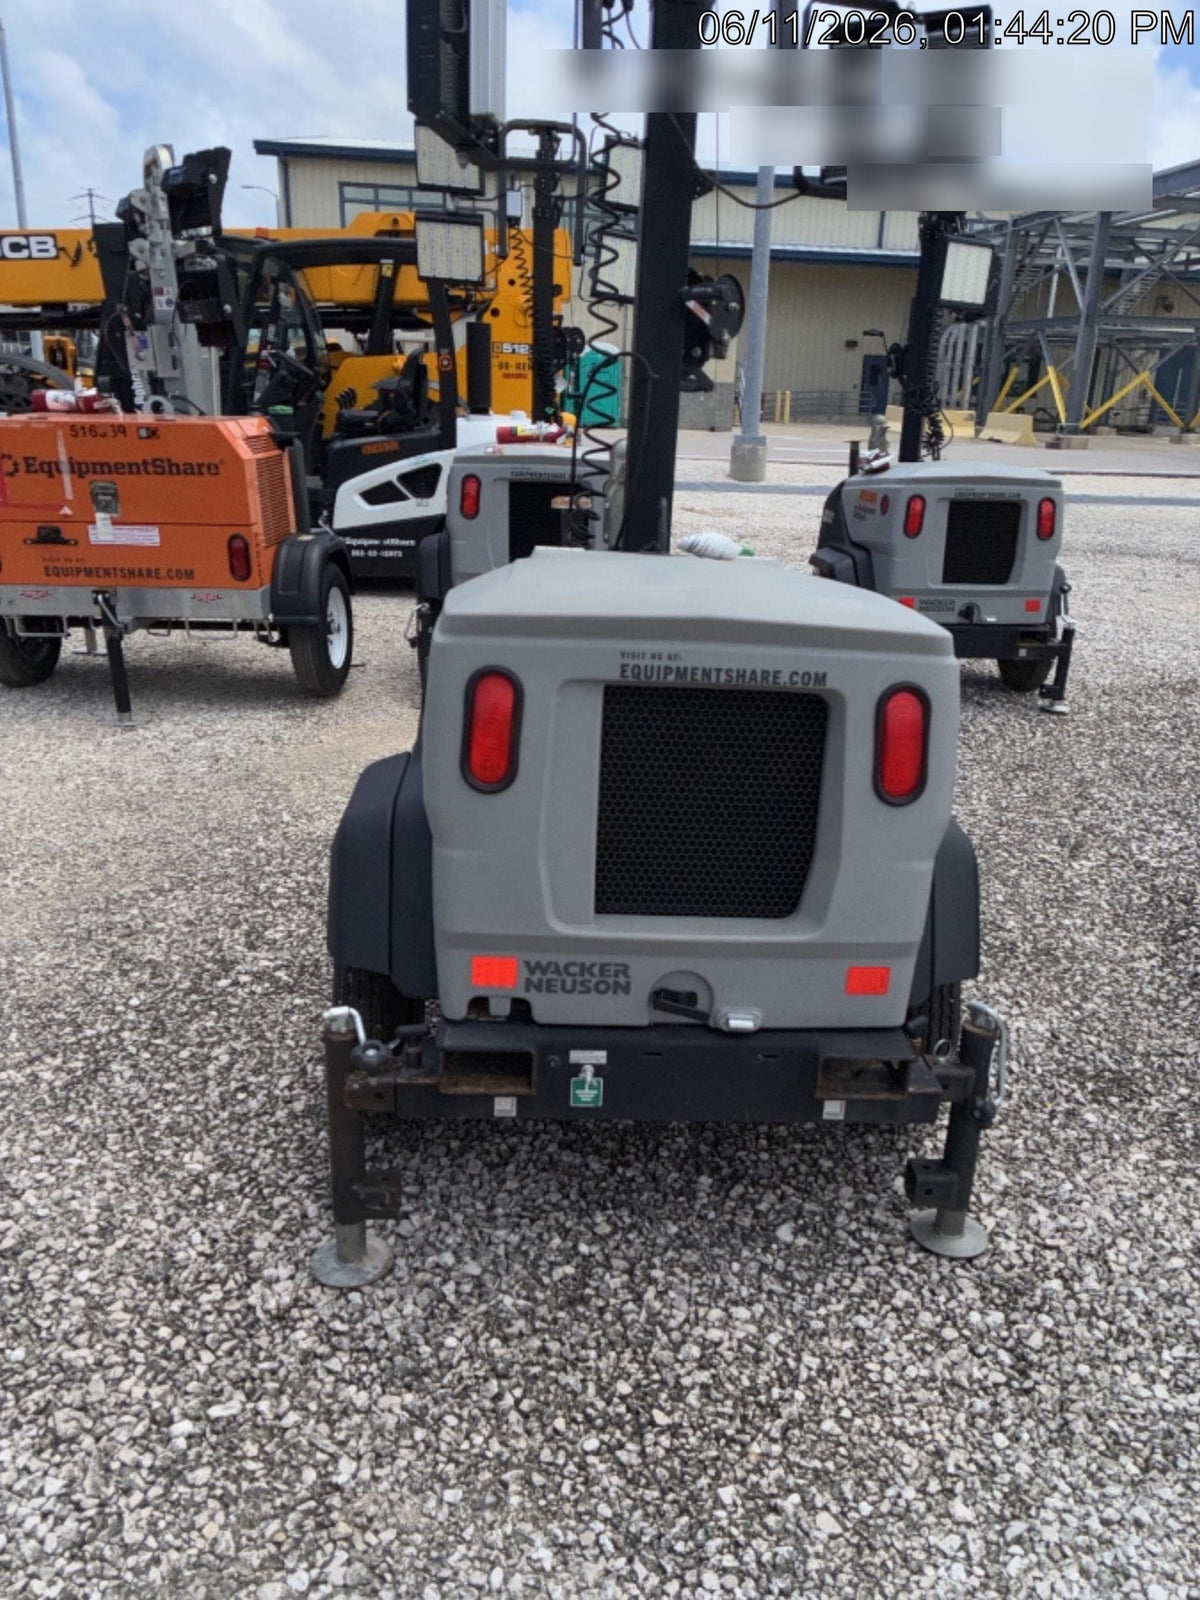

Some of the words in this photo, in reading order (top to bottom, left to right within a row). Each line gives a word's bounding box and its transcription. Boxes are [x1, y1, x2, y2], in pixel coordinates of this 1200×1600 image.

[0, 235, 57, 259] CB
[24, 456, 220, 478] EquipmentShare
[44, 565, 195, 581] EQUIPMENTSHARE.COM
[620, 651, 645, 660] VISIT
[650, 652, 662, 660] US
[620, 663, 827, 687] EQUIPMENTSHARE.COM
[523, 960, 630, 978] WACKER
[524, 978, 631, 995] NEUSON
